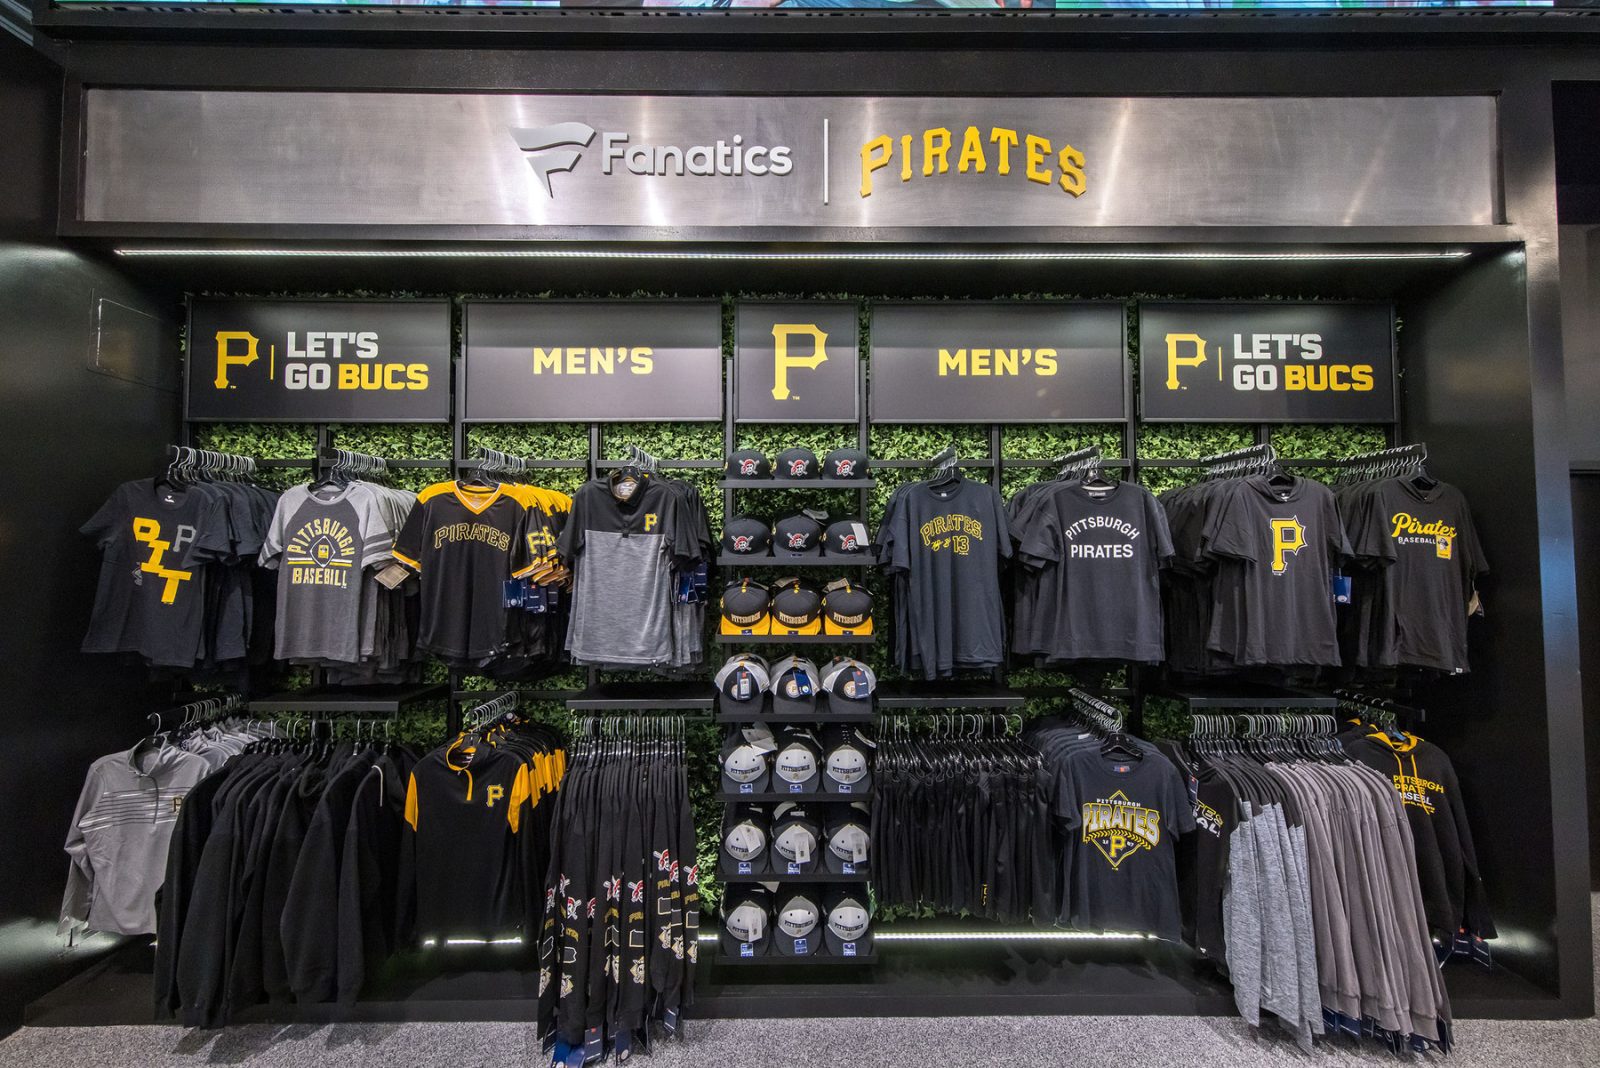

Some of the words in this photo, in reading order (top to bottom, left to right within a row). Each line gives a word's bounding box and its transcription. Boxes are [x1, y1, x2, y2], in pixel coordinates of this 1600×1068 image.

[602, 132, 793, 176] Fanatics
[859, 125, 1088, 198] PIRATES
[286, 331, 379, 359] LET'S
[1233, 333, 1323, 360] LET'S
[215, 331, 259, 389] P
[533, 346, 654, 375] MEN’S
[771, 324, 829, 401] P
[938, 348, 1058, 376] MEN’S
[1165, 333, 1208, 391] P
[284, 363, 331, 391] GO
[338, 363, 429, 391] BUCS
[1232, 364, 1277, 391] GO
[1285, 364, 1375, 391] BUCS
[644, 513, 657, 531] P
[920, 514, 982, 546] PIRATES
[1065, 516, 1140, 541] PITTSBURGH
[1391, 512, 1457, 538] Pirates
[287, 518, 355, 556] PITTSBURGH
[434, 522, 510, 552] PIRATES
[952, 535, 969, 553] 13
[1270, 515, 1308, 574] P
[1397, 536, 1436, 545] BASEBALL
[1071, 544, 1134, 559] PIRATES
[486, 784, 504, 808] P
[1096, 798, 1141, 808] PITTSBURGH
[1083, 802, 1160, 847] PIRATES
[1110, 834, 1127, 858] P
